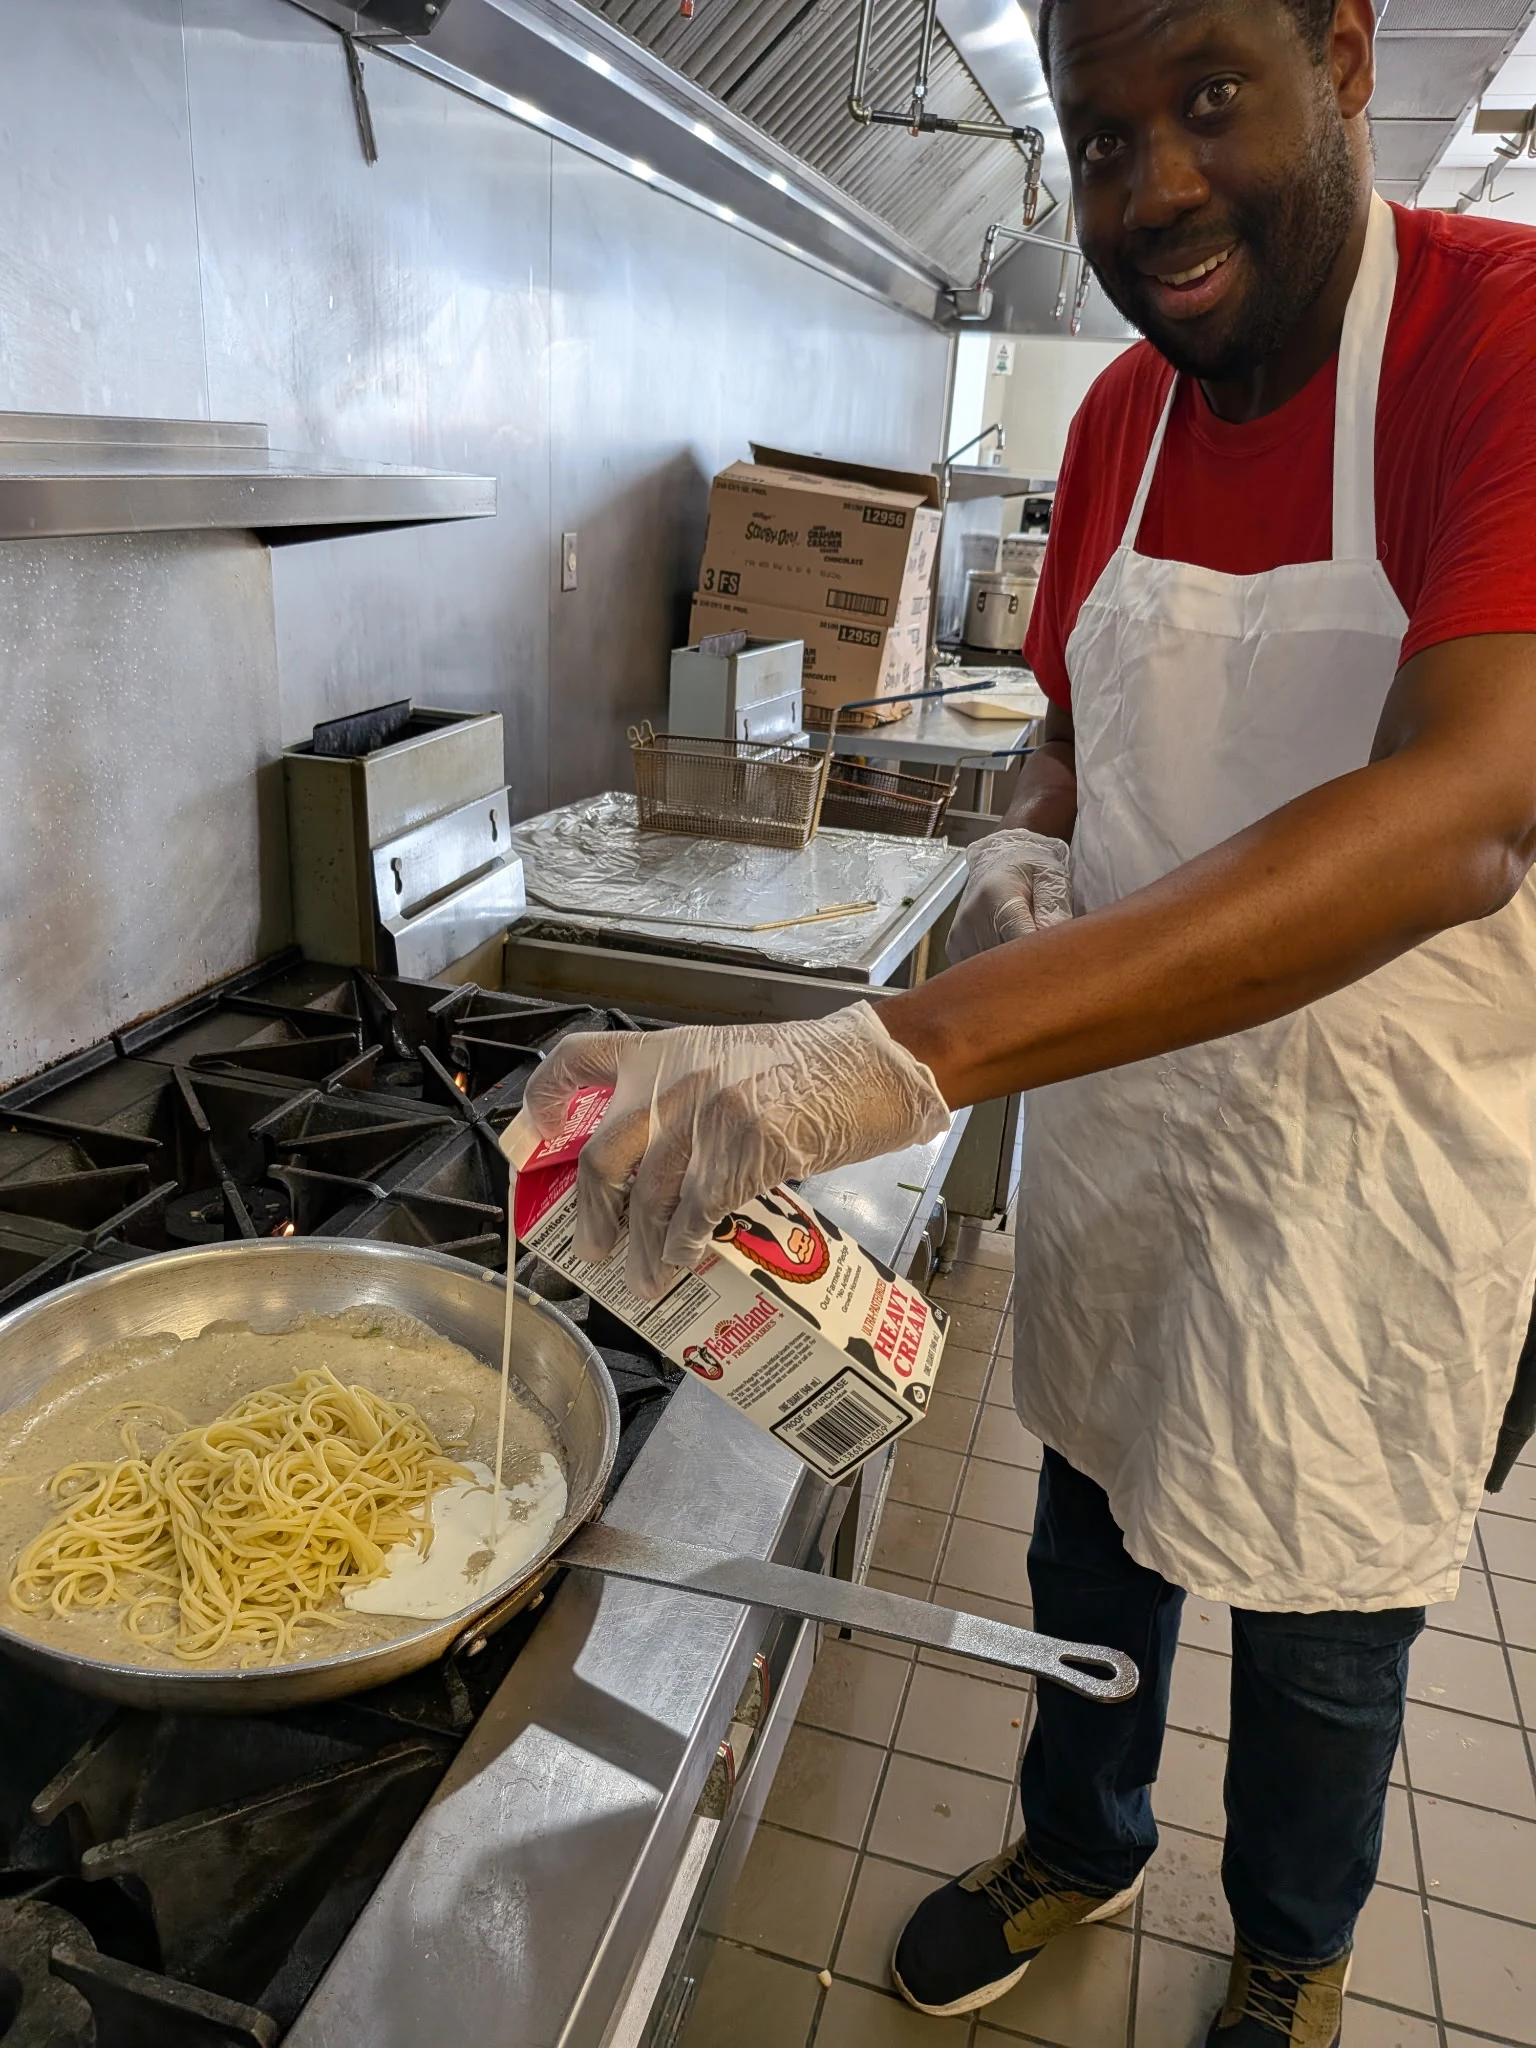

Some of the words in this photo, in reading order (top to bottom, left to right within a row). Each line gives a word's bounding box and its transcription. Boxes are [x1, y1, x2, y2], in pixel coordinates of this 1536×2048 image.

[808, 529, 842, 539] GRAHAM
[865, 509, 904, 527] 12956
[807, 539, 842, 548] CRACKER
[824, 556, 863, 566] CHOCOLATE
[704, 568, 715, 590] 3
[720, 573, 738, 593] FS
[840, 627, 879, 645] 12956
[803, 672, 837, 682] HOCOLATE
[530, 1212, 566, 1248] Nutrition
[819, 1293, 830, 1310] Our
[826, 1265, 842, 1295] Farmers
[837, 1244, 848, 1266] Pledge
[840, 1265, 852, 1289] Artificial
[841, 1290, 853, 1313] Growth
[849, 1264, 861, 1291] Hormones
[861, 1278, 887, 1337] ULTRA-PASTEURIZED
[873, 1284, 908, 1361] HEAVY
[704, 1292, 779, 1360] Farmland
[731, 1339, 754, 1358] FRESH
[750, 1318, 777, 1342] DAIRIES
[893, 1296, 928, 1377] CREAM
[777, 1401, 791, 1412] ONE
[785, 1391, 804, 1406] QUART
[782, 1413, 805, 1432] PROOF
[801, 1406, 814, 1416] OF
[811, 1377, 849, 1409] PURCHASE
[839, 1446, 864, 1464] 13868
[864, 1425, 889, 1446] 02009
